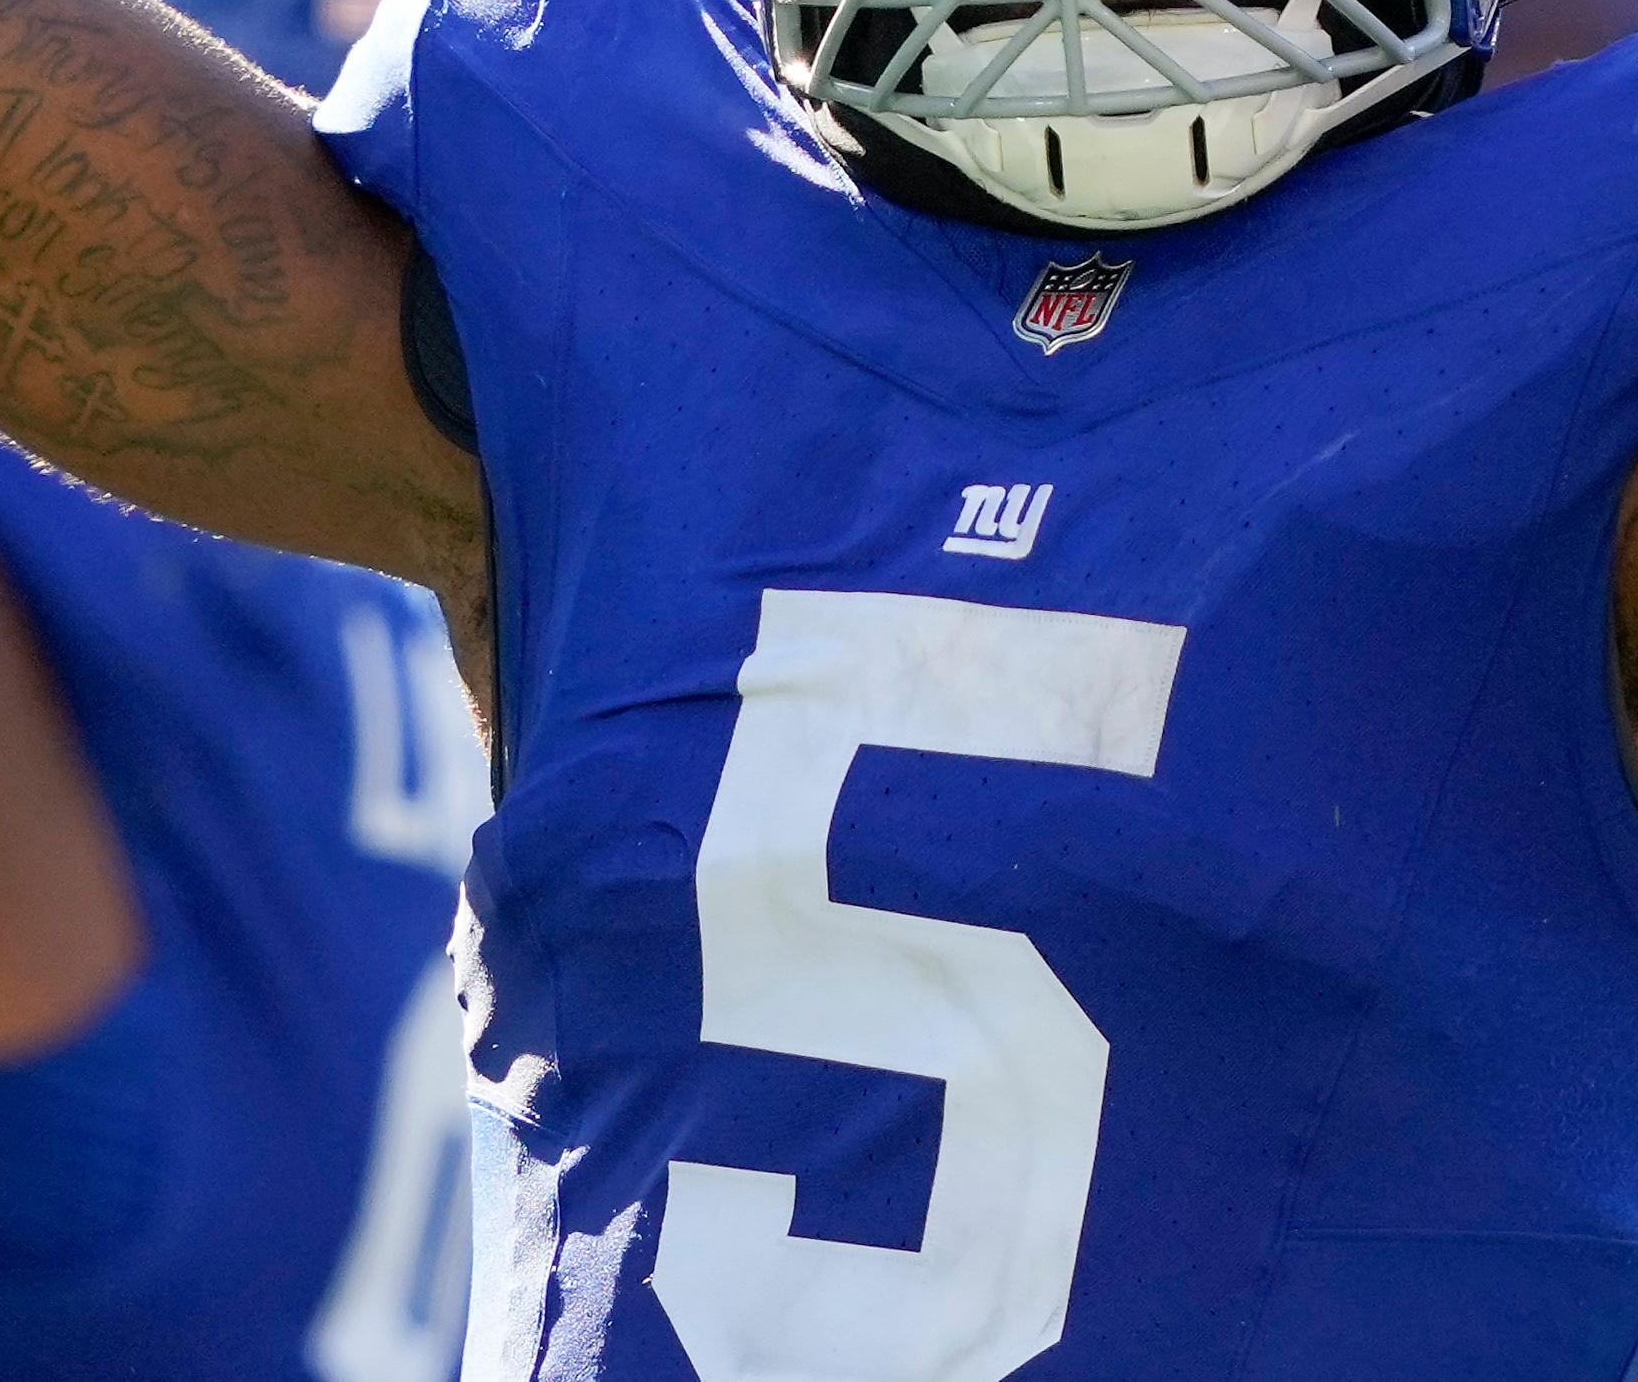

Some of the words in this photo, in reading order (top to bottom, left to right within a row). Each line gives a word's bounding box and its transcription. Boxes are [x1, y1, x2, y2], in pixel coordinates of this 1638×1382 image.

[1029, 292, 1098, 331] NFL
[943, 484, 1053, 560] ny
[649, 588, 1186, 1382] 5
